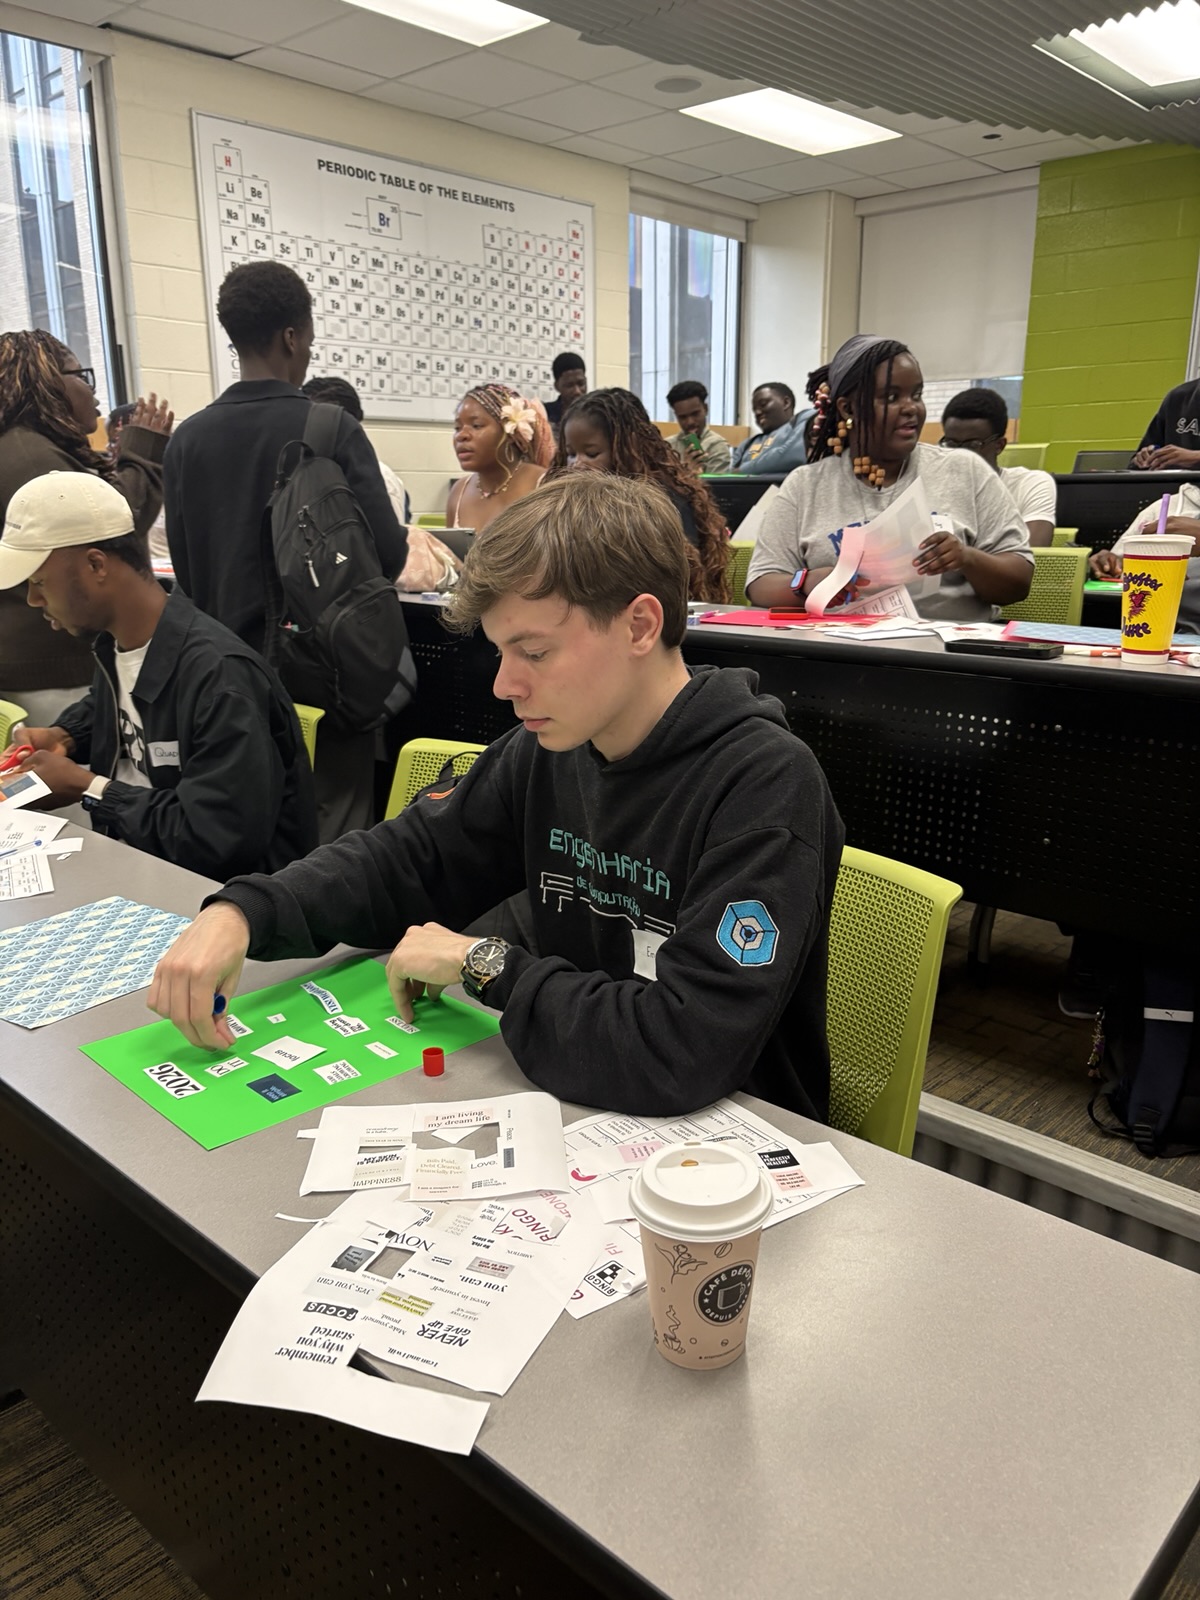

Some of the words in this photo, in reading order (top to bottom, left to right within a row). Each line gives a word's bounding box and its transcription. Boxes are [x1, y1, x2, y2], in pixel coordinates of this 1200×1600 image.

[317, 158, 377, 182] PERIODIC
[379, 172, 416, 192] TABLE
[419, 182, 434, 195] OF
[437, 186, 460, 201] THE
[462, 191, 516, 213] ELEMENTS
[275, 1049, 300, 1062] focus
[228, 1059, 244, 1068] IT
[210, 1065, 230, 1076] DO
[149, 1063, 201, 1096] 2026
[445, 1117, 474, 1126] dream
[475, 1114, 491, 1123] life
[458, 1110, 484, 1118] living
[470, 1160, 498, 1170] Love.
[352, 1176, 402, 1187] HAPPINESS
[316, 1276, 334, 1286] can
[334, 1281, 354, 1291] you
[459, 1274, 482, 1287] can.
[483, 1281, 508, 1292] you
[587, 1274, 616, 1295] BINGO
[704, 1273, 728, 1296] CAFÉ
[355, 1285, 374, 1295] yes,
[430, 1285, 462, 1298] yourself
[461, 1293, 470, 1301] in
[471, 1297, 491, 1307] Invest
[307, 1302, 357, 1320] FOCUS
[705, 1308, 732, 1321] DEPUIS
[360, 1315, 390, 1329] yourself
[380, 1313, 402, 1324] proud.
[427, 1319, 444, 1329] UP
[309, 1325, 355, 1340] started
[388, 1325, 407, 1336] Make
[416, 1324, 469, 1347] NEVER
[443, 1324, 472, 1336] GIVE
[296, 1336, 322, 1348] you
[319, 1338, 344, 1353] why
[274, 1347, 338, 1365] remember
[387, 1347, 402, 1355] will.
[420, 1358, 434, 1366] can
